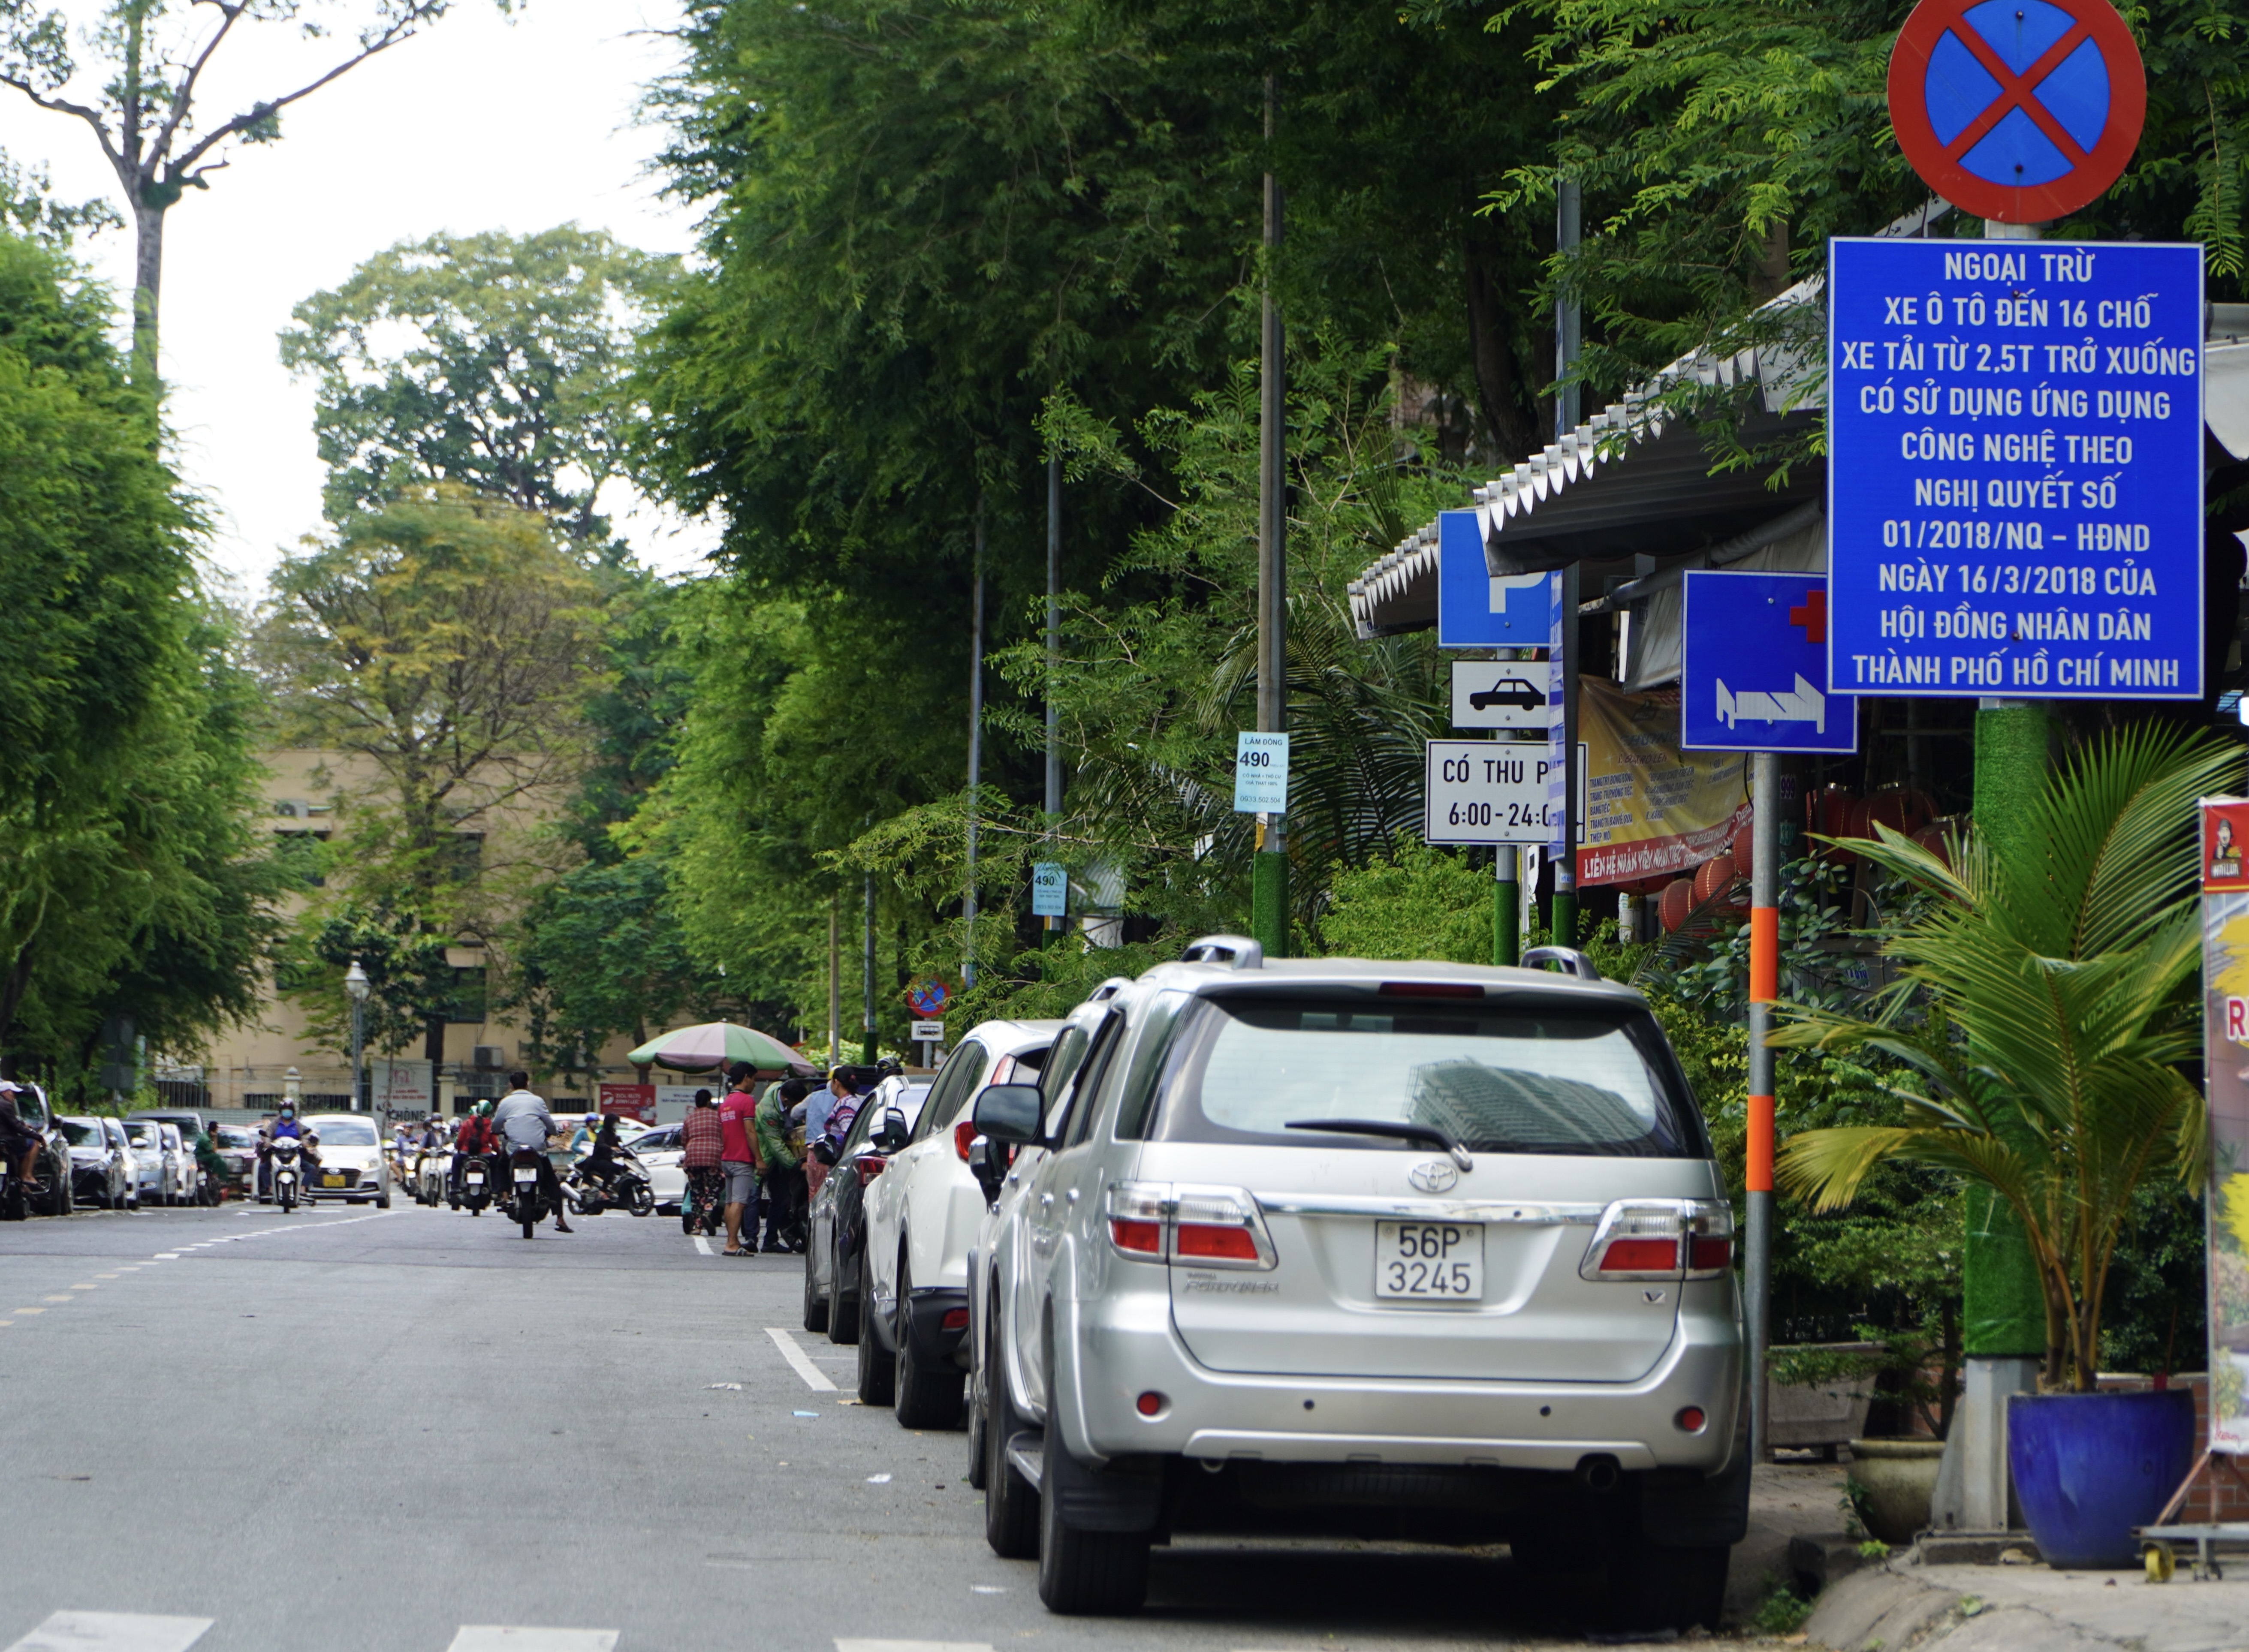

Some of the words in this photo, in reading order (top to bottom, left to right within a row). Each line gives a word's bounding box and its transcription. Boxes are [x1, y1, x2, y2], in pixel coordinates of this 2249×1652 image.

[1945, 252, 2026, 286] NGOẠI
[2040, 247, 2095, 282] TRỪ
[1884, 297, 1917, 325] XE
[1926, 291, 1943, 325] Ô
[1953, 292, 1985, 326] TÔ
[1995, 288, 2048, 327] ĐẾN
[2059, 300, 2087, 328] 16
[2098, 293, 2159, 328] CHỖ
[1841, 341, 1875, 369] XE
[1884, 334, 1924, 370] TẢI
[1933, 335, 1969, 371] TỪ
[2044, 337, 2098, 373] TRỞ
[2106, 337, 2195, 376] XUỐNG
[1860, 377, 1894, 413] CÓ
[1903, 378, 1941, 415] SỬ
[1950, 388, 2022, 421] DỤNG
[2032, 381, 2088, 418] ỨNG
[2098, 390, 2170, 424] DỤNG
[1902, 426, 1974, 461] CÔNG
[1984, 428, 2056, 468] NGHỆ
[2064, 435, 2132, 464] THEO
[1915, 478, 1978, 512] NGHỊ
[1987, 470, 2074, 509] QUYẾT
[2082, 472, 2122, 509] SỐ
[2078, 523, 2150, 551] HĐND
[1880, 557, 1949, 592] NGÀY
[1959, 565, 2095, 595] 16/3/2018
[2105, 558, 2157, 596] CỦA
[1881, 605, 1924, 643] HỘI
[1933, 601, 2007, 639] ĐỒNG
[2017, 607, 2089, 640] NHÂN
[2098, 608, 2151, 640] DÂN
[1852, 647, 1940, 684] THÀNH
[1951, 647, 2008, 685] PHỐ
[2014, 648, 2049, 685] HỒ
[2058, 651, 2104, 686] CHÍ
[2110, 659, 2178, 686] MINH
[1239, 751, 1269, 767] 490
[1245, 737, 1261, 745] LÂM
[1443, 753, 1469, 783] CÓ
[1483, 760, 1524, 784] THU
[1035, 875, 1055, 886] 490
[1584, 851, 1606, 879] LIÊN
[1606, 849, 1616, 880] HỆ
[1399, 1226, 1461, 1259] 56P
[1388, 1261, 1471, 1294] 3245
